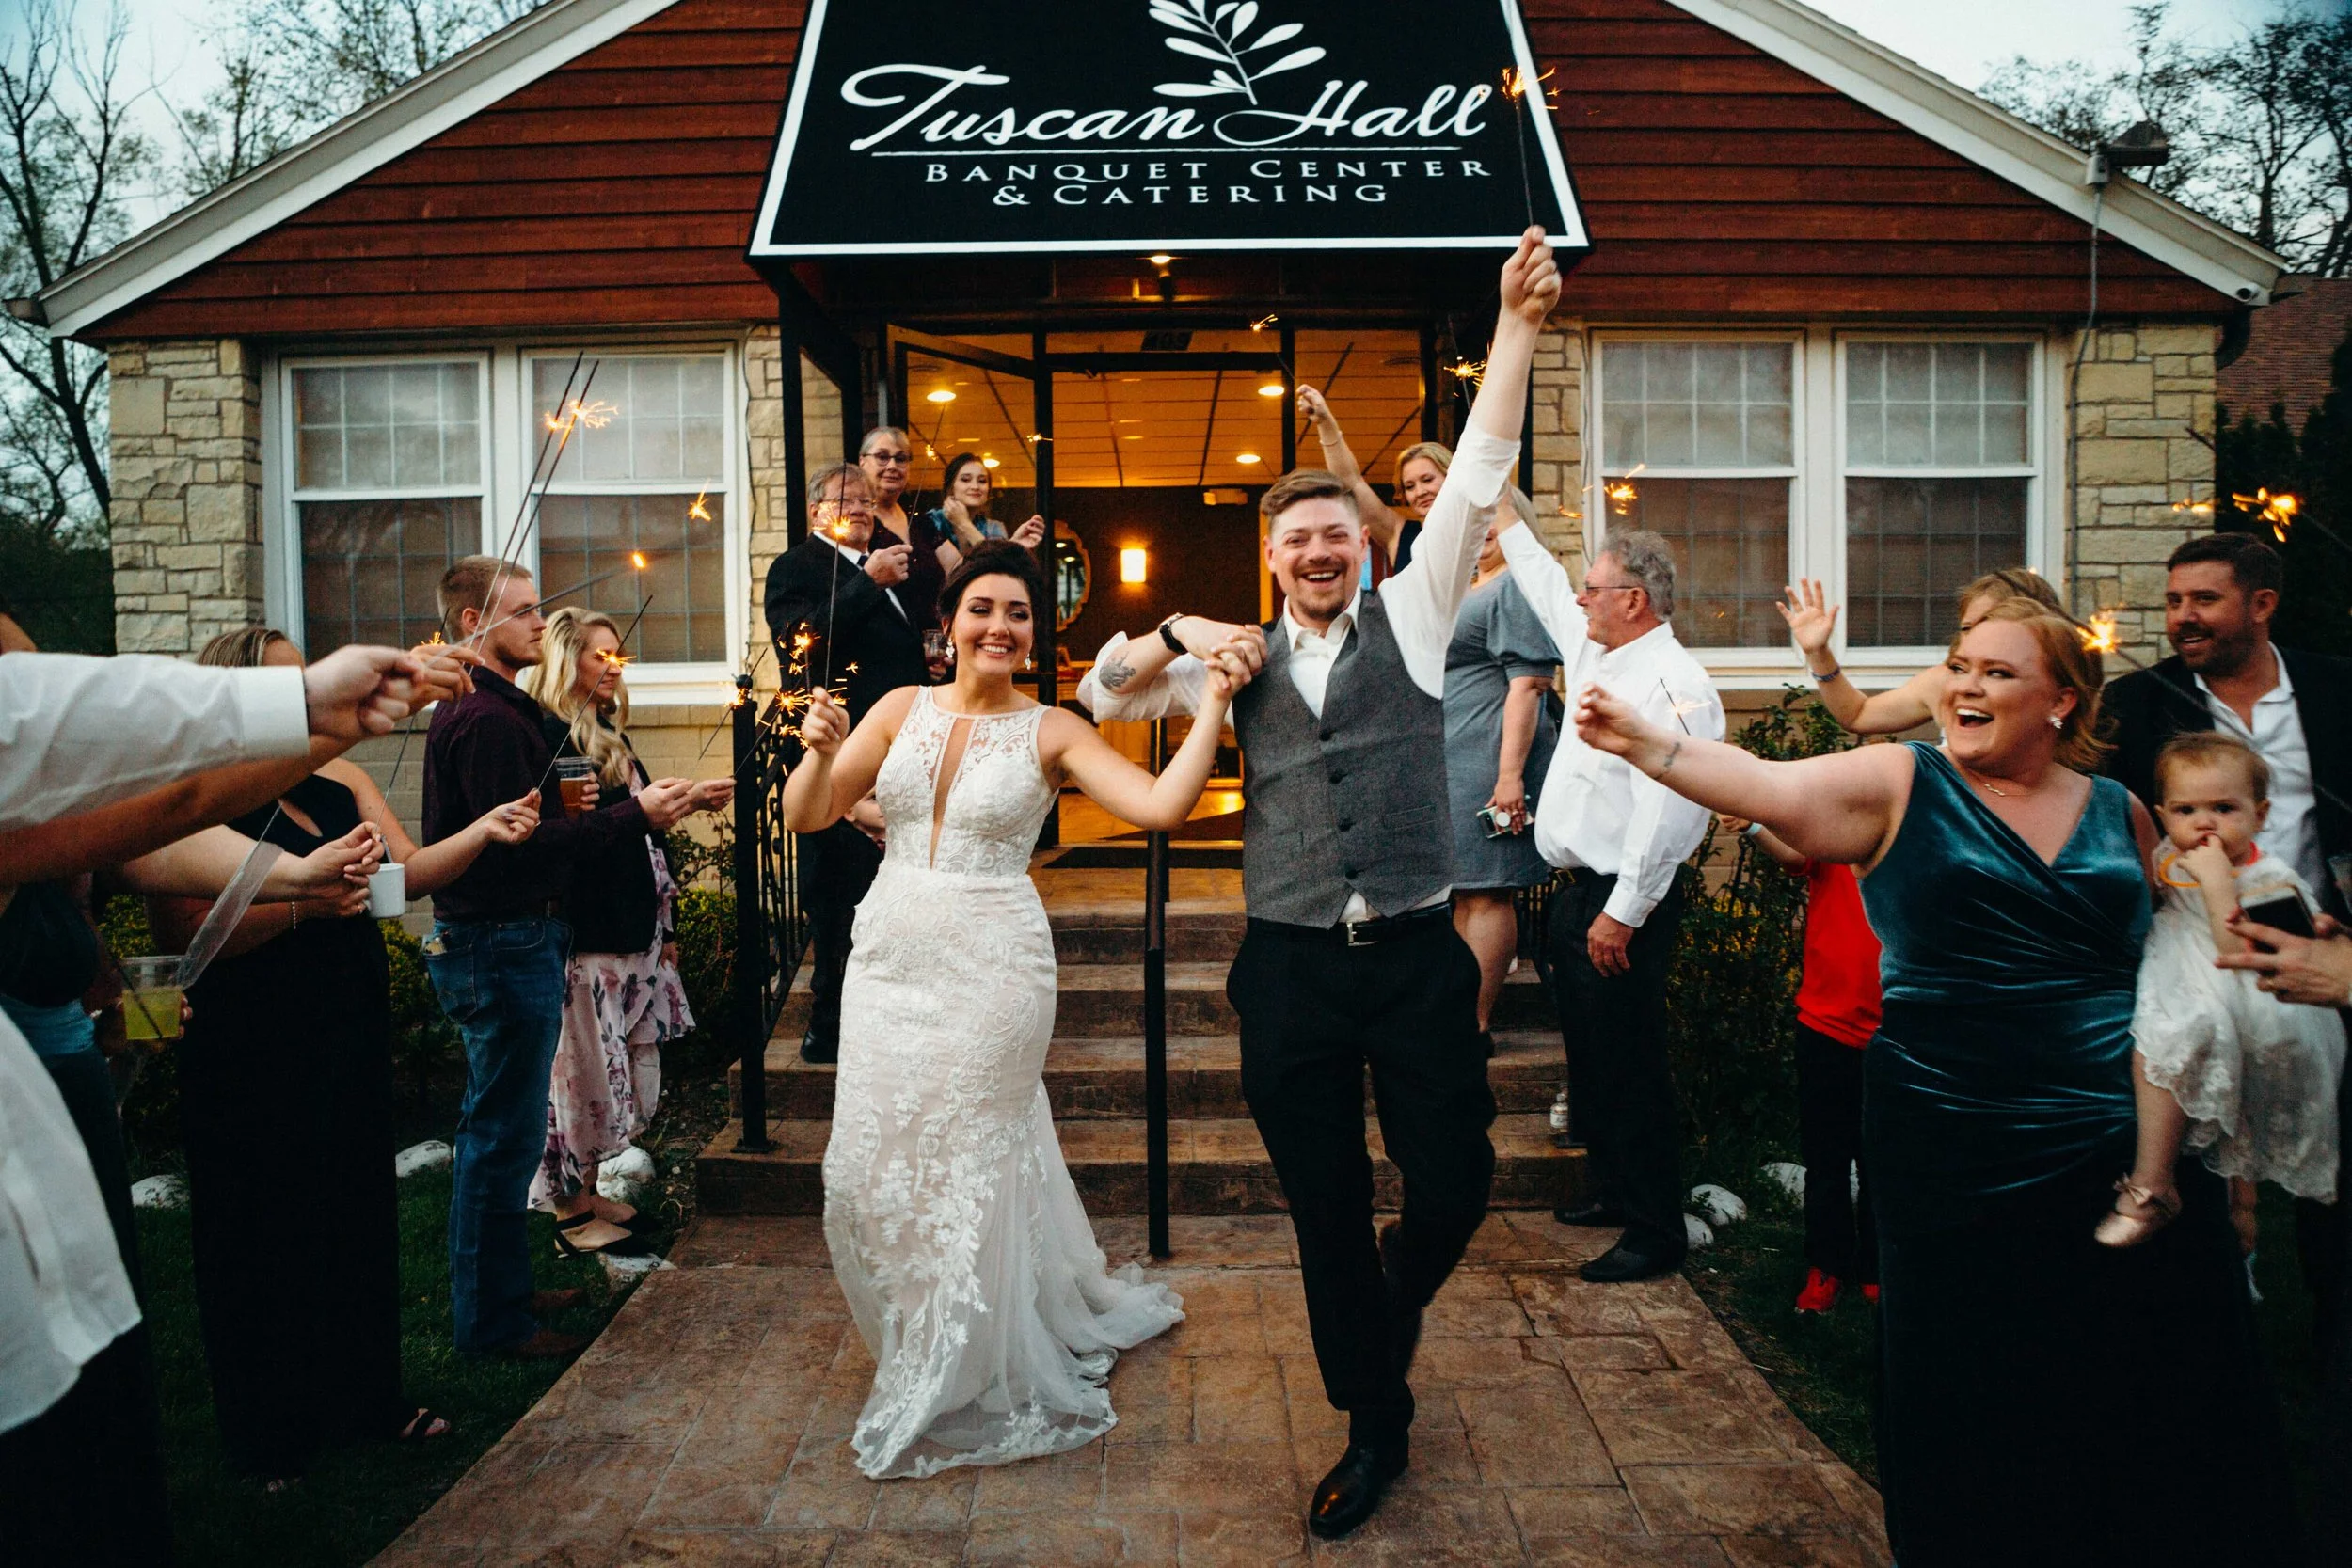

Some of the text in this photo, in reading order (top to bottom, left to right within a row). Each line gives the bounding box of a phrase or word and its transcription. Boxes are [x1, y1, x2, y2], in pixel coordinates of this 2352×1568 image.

[840, 63, 1494, 151] Tuscan Hall
[925, 159, 1493, 183] BANQUET CENTER
[992, 183, 1388, 207] & CATERING
